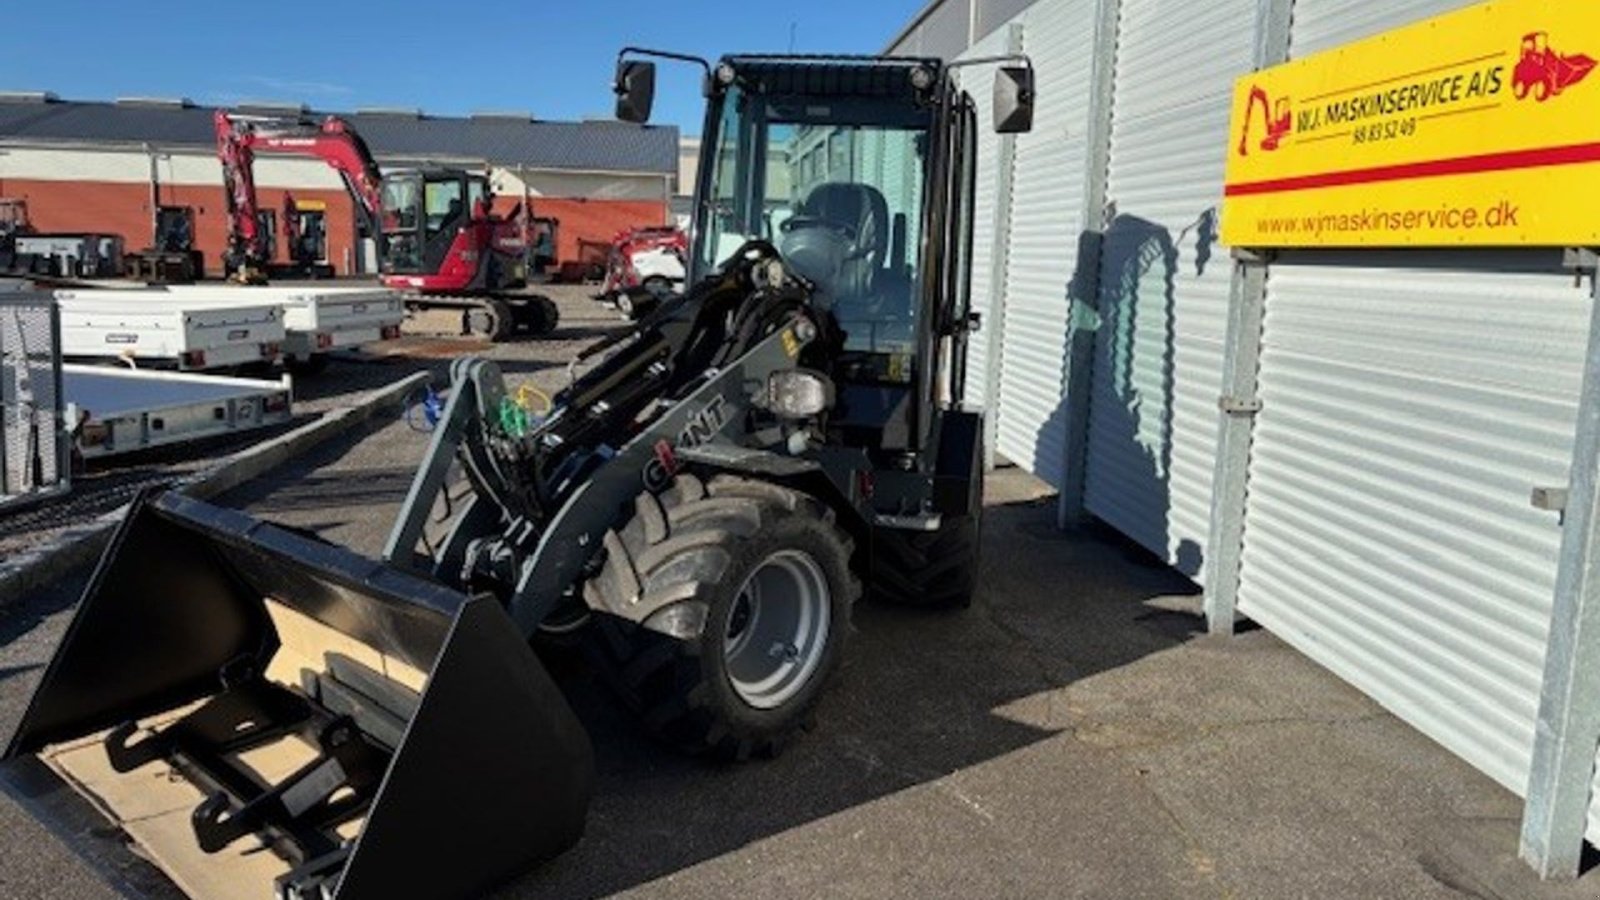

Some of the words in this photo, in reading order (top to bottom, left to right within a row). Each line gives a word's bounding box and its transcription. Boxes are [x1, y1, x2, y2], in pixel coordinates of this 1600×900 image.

[1325, 75, 1463, 123] MASKINSERVICE
[1465, 66, 1504, 98] A/S
[1368, 123, 1383, 141] 83
[1384, 120, 1399, 139] 52
[1400, 118, 1416, 136] 49
[1257, 200, 1519, 238] www.wjmaskinservice.dk
